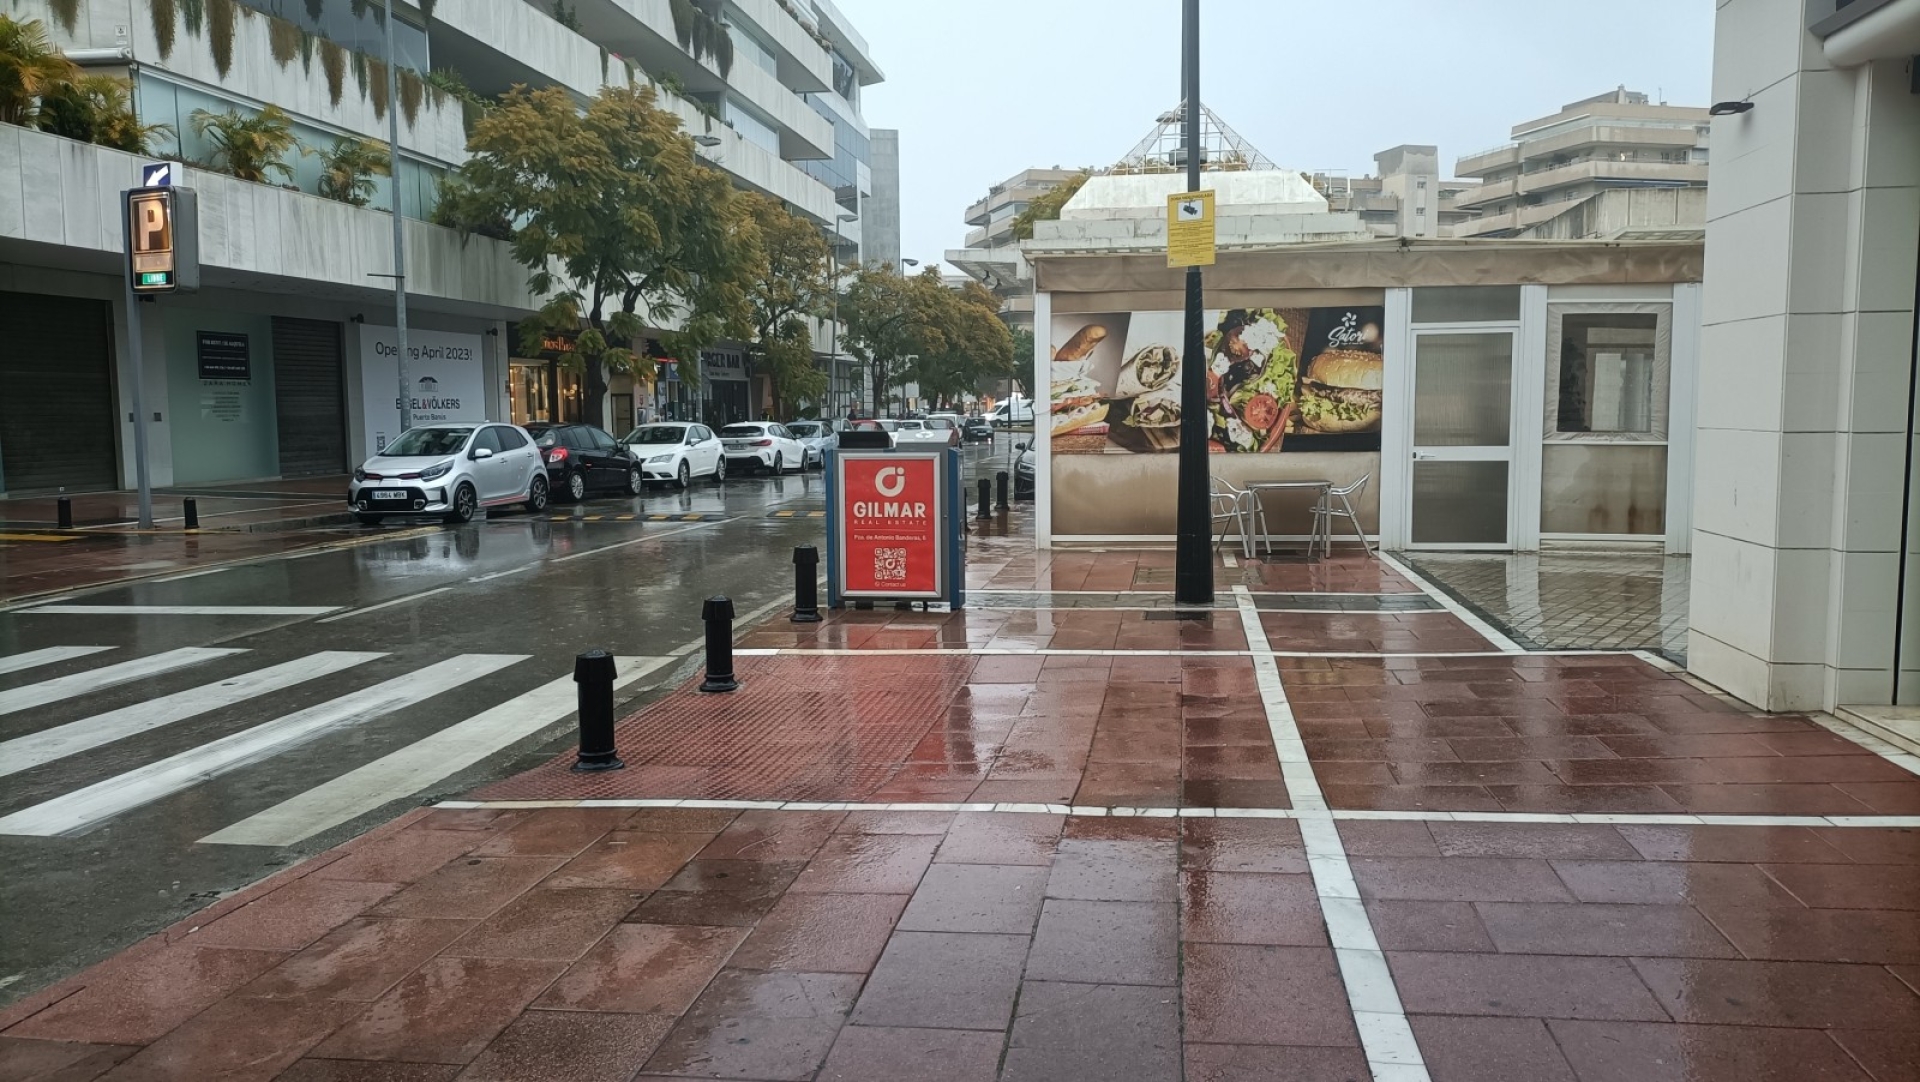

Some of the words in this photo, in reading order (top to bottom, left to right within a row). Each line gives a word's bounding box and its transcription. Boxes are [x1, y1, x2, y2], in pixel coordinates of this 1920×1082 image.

[138, 200, 163, 250] P
[375, 341, 420, 360] Openg
[421, 345, 444, 360] April
[445, 347, 473, 361] 2023!
[395, 396, 461, 410] EEL&VÖLKERS
[412, 413, 430, 421] Puerto
[853, 501, 926, 518] GILMAR
